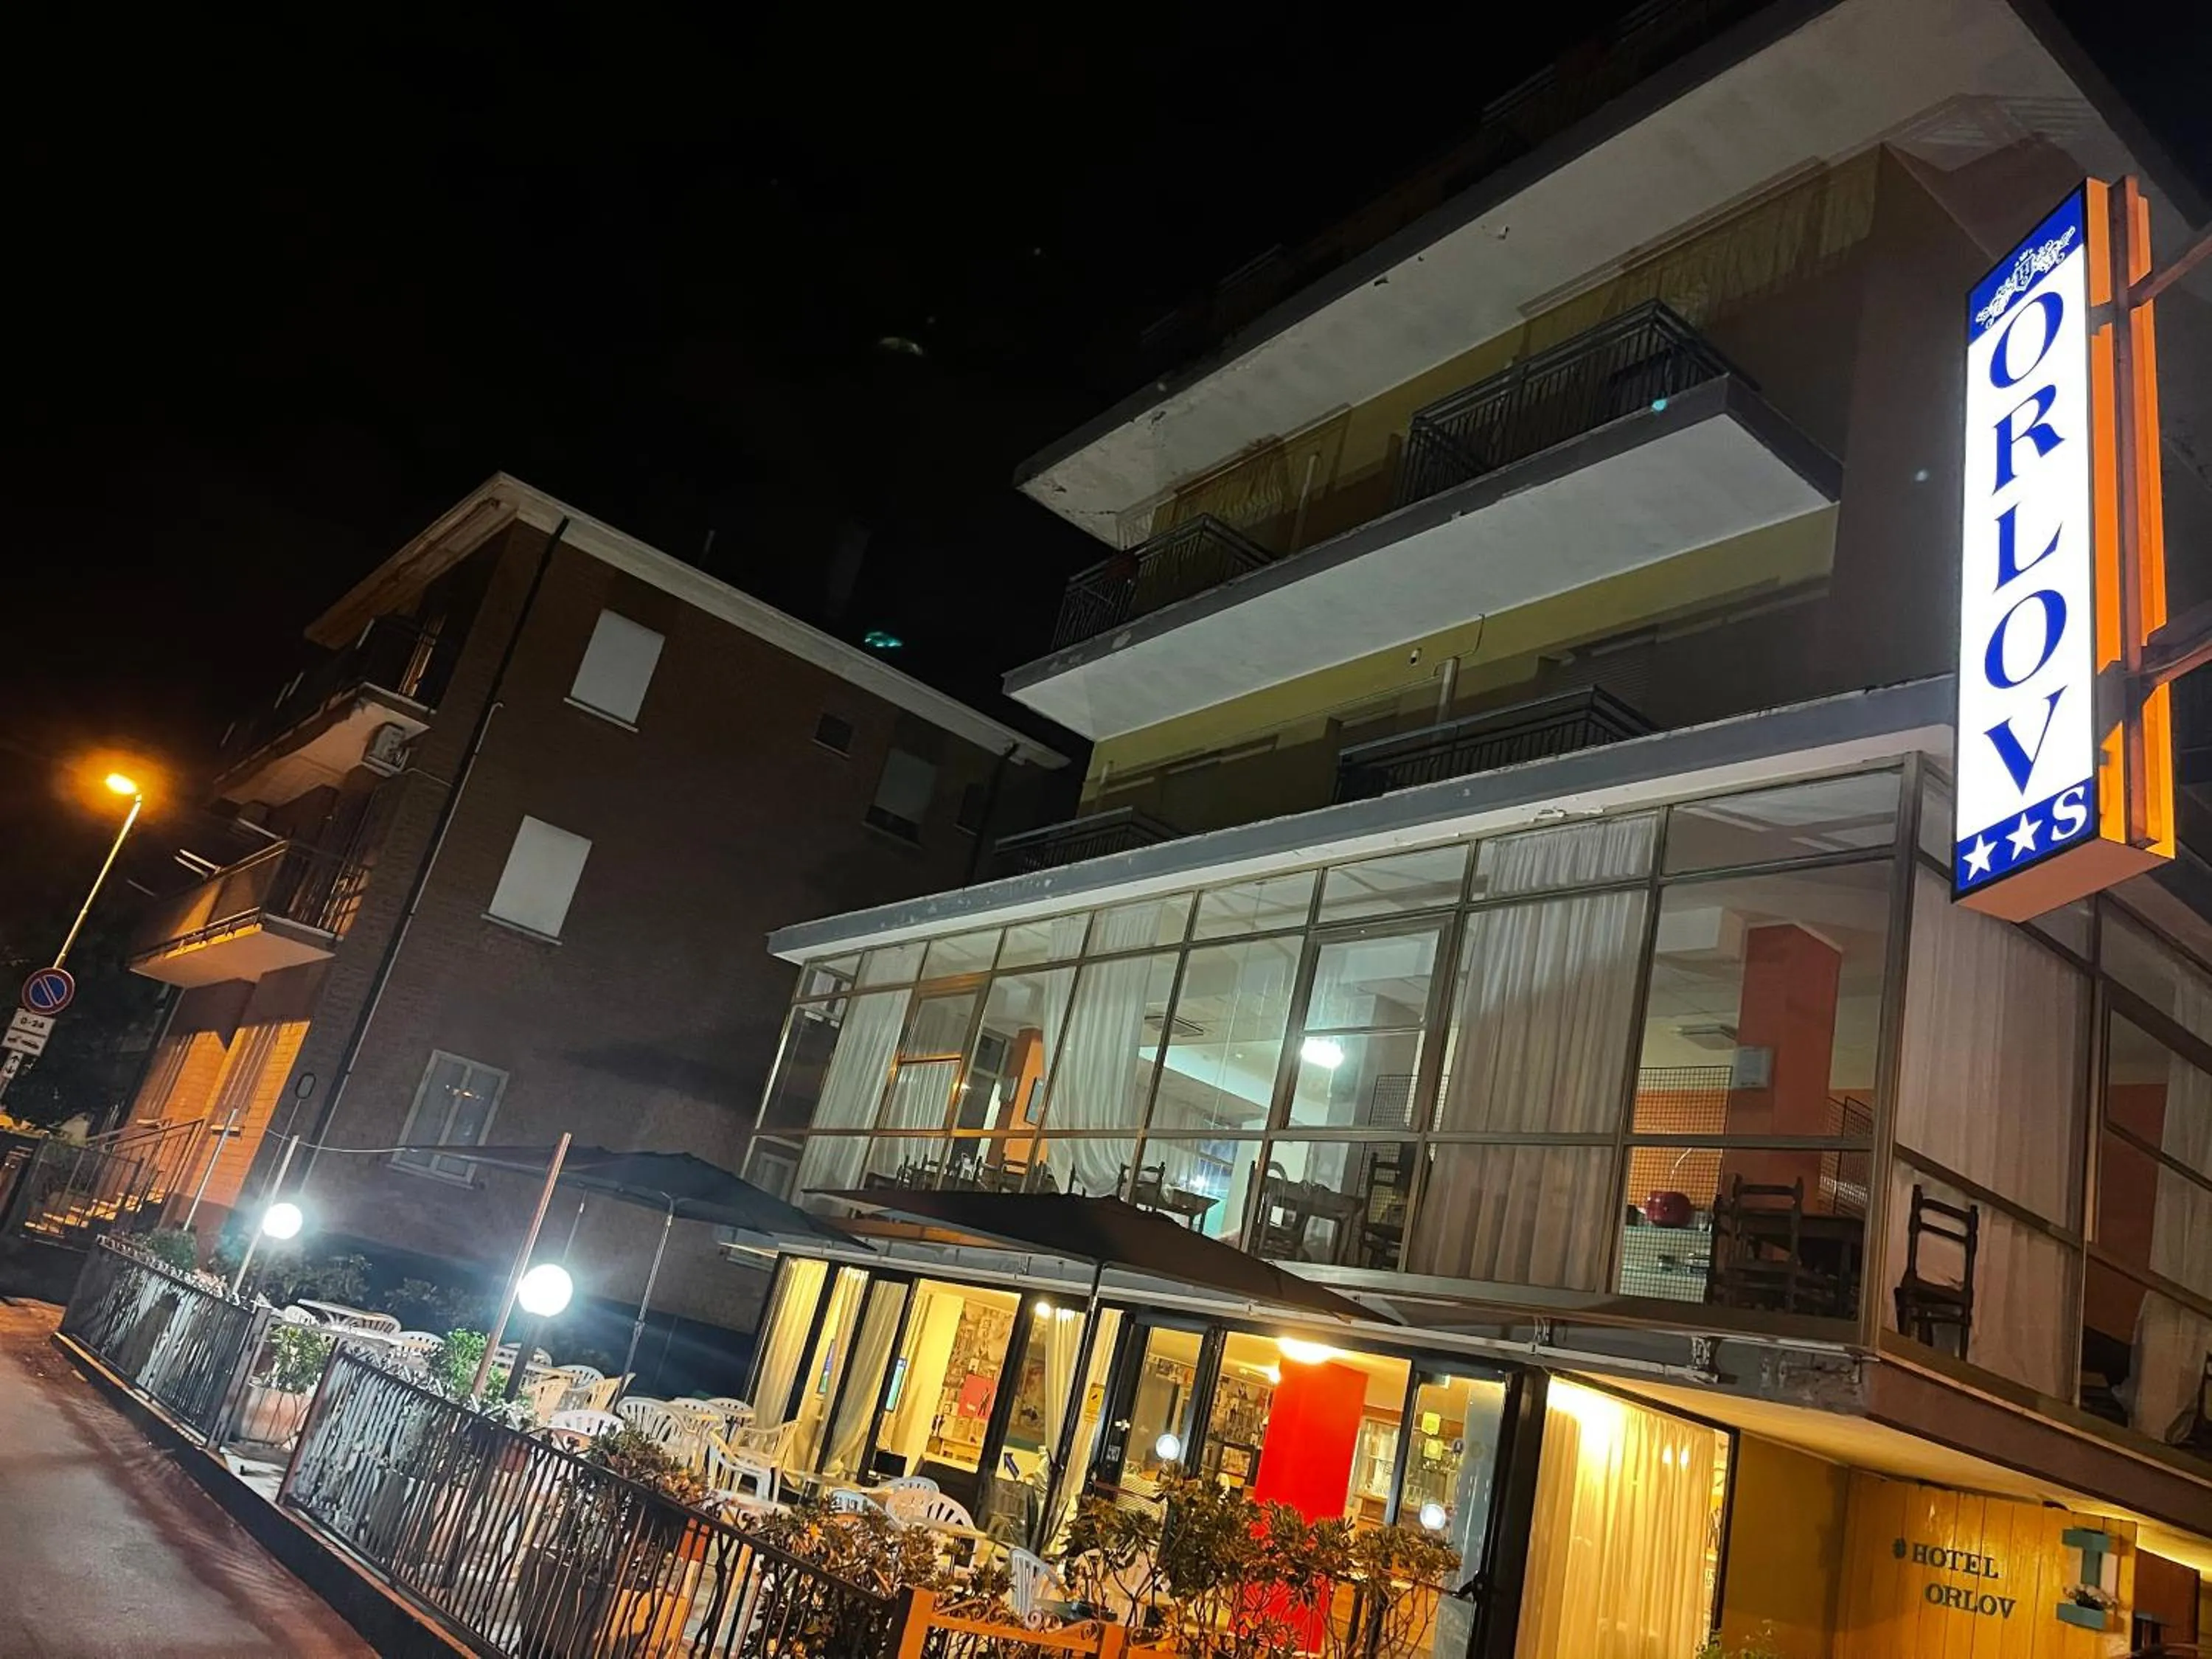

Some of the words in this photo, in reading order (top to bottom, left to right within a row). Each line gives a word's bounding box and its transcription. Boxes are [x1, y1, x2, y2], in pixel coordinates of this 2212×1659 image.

[1983, 291, 2067, 796] ORLOV
[1912, 1543, 1999, 1579] HOTEL
[1924, 1583, 2017, 1619] ORLOV
